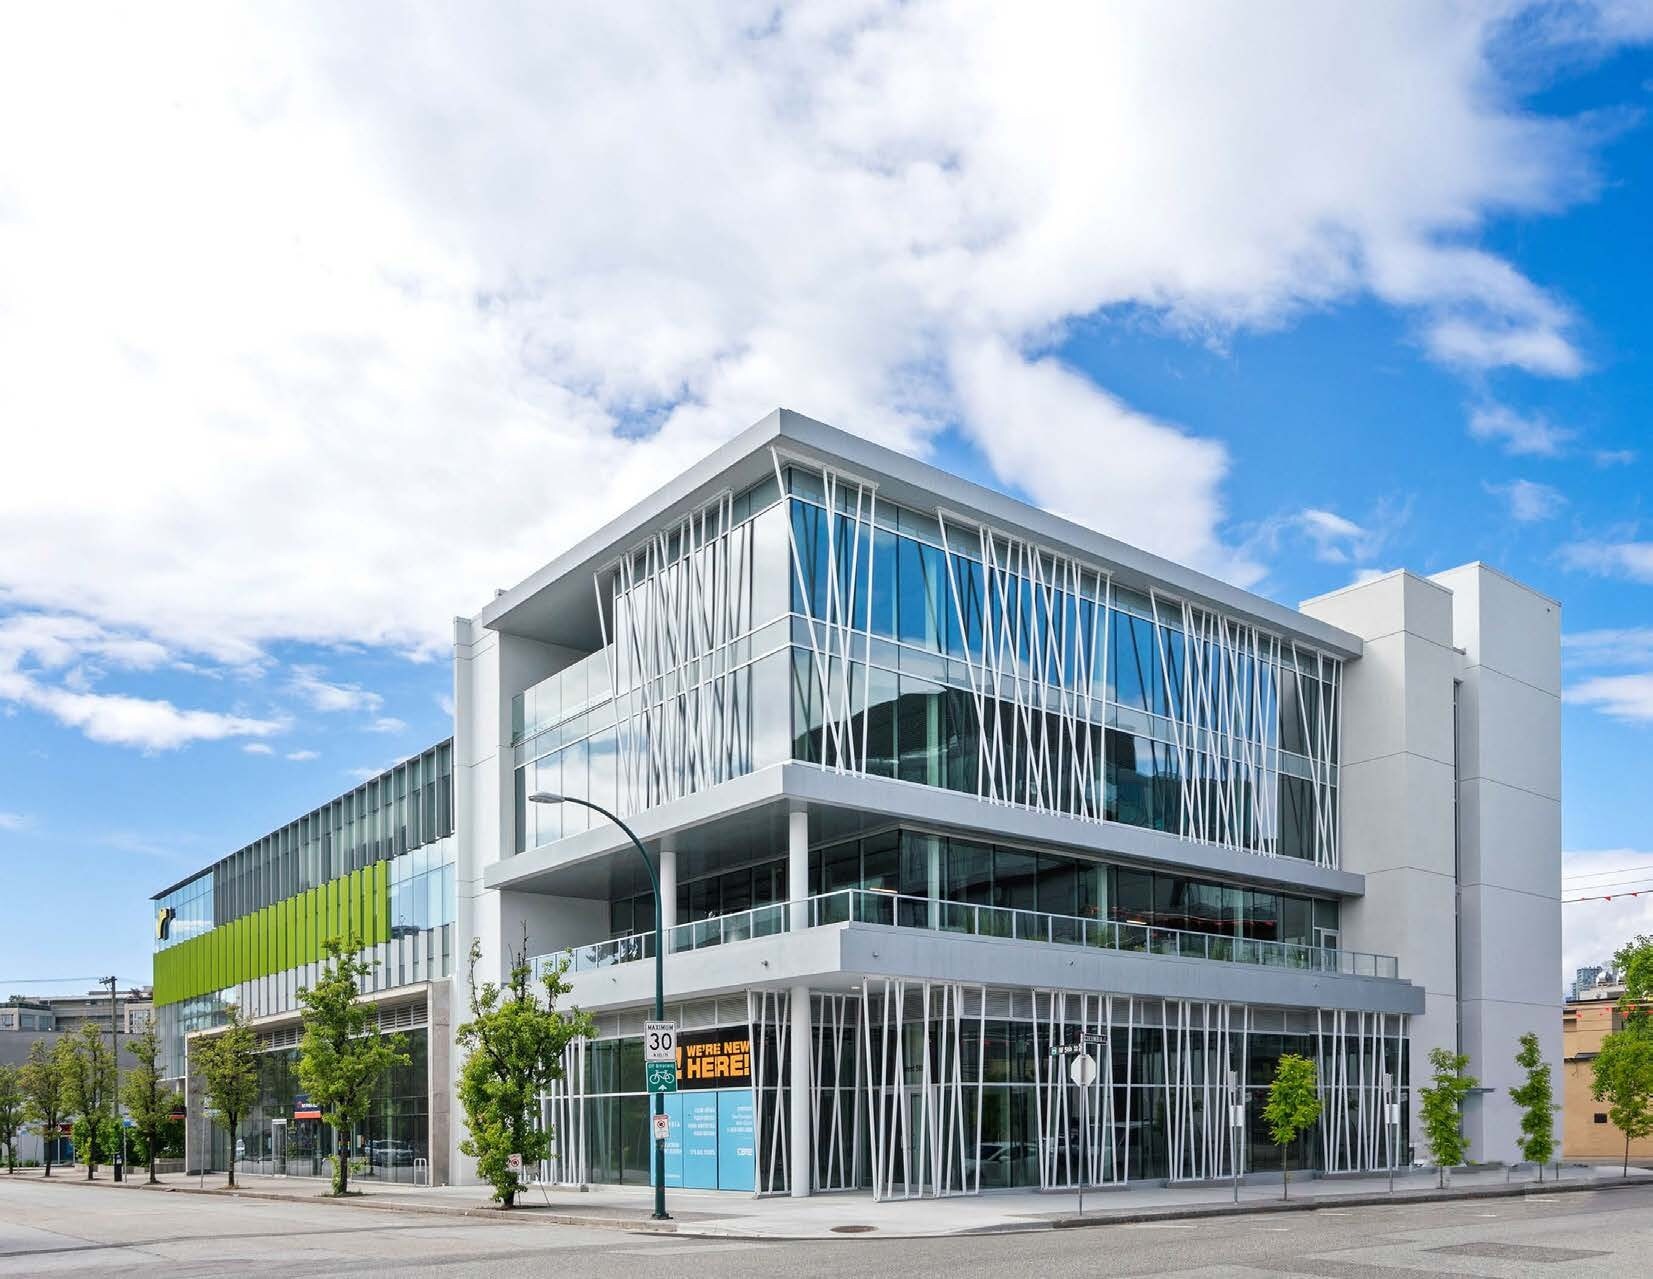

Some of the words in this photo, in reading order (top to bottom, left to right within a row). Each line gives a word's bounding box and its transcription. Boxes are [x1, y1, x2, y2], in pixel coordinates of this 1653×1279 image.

[650, 1033, 672, 1050] 30
[687, 1043, 721, 1057] WE'RE
[724, 1040, 750, 1054] NEW
[687, 1054, 750, 1079] HERE!
